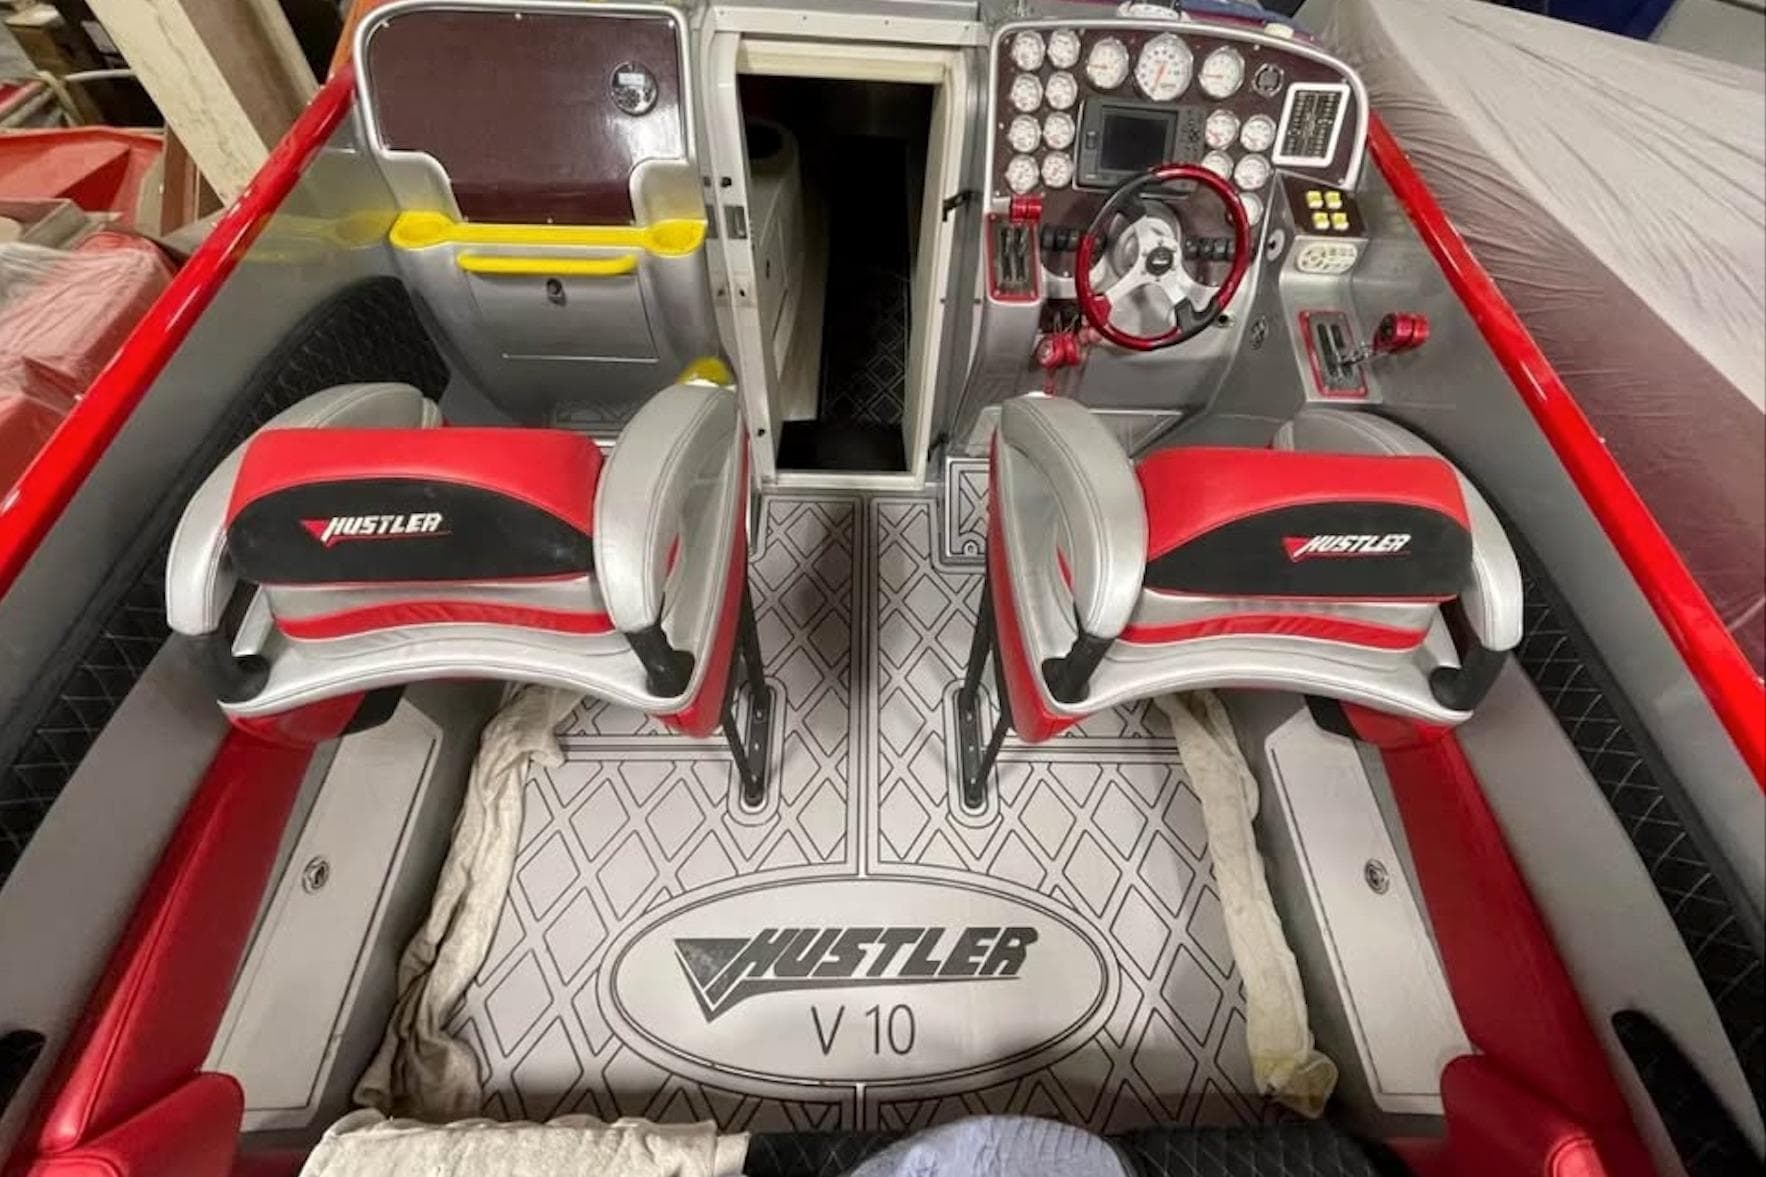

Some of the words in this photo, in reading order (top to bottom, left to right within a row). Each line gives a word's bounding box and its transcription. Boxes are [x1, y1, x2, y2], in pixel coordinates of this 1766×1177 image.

[319, 512, 443, 543] HUSTLER
[1292, 533, 1412, 558] HUSTLER
[702, 926, 1040, 1010] HUSTLER
[810, 1005, 846, 1056] V
[864, 1003, 917, 1056] 10
